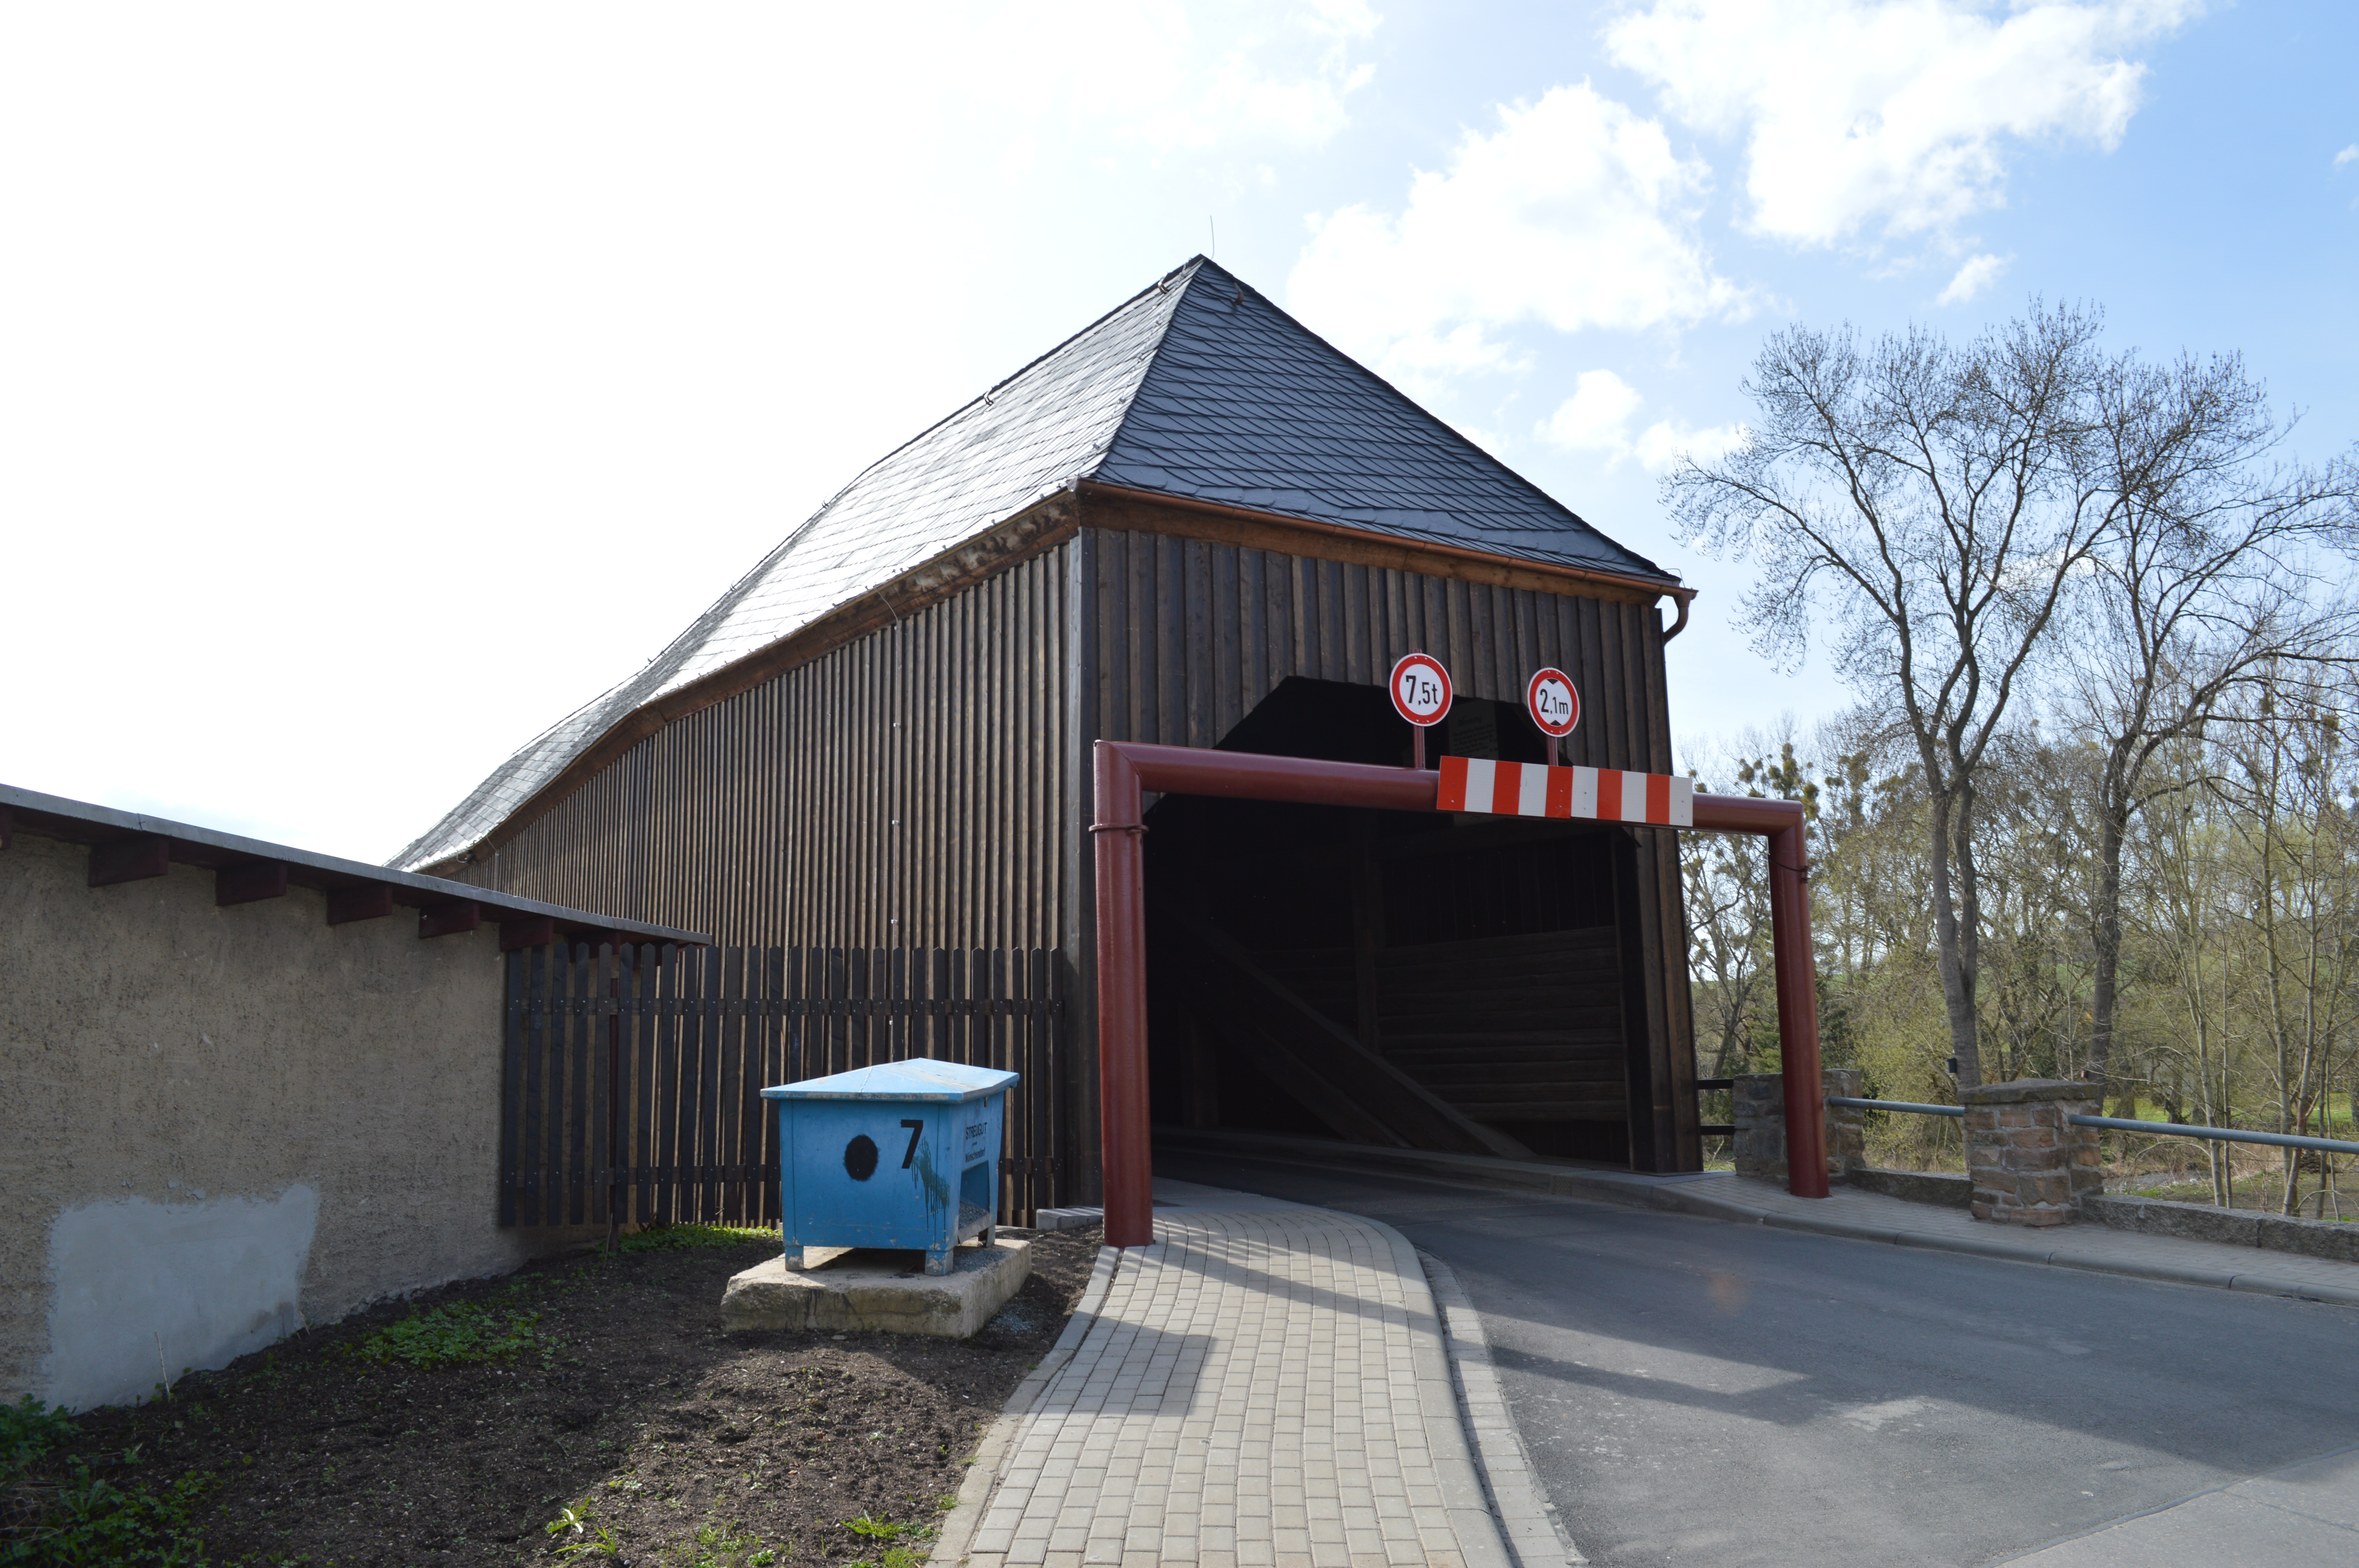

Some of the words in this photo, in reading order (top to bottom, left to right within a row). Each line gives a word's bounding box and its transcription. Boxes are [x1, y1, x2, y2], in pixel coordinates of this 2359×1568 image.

[1405, 675, 1439, 705] 7,5t
[1539, 688, 1569, 715] 2,1m
[900, 1119, 923, 1169] 7
[965, 1122, 987, 1140] STREUGUT
